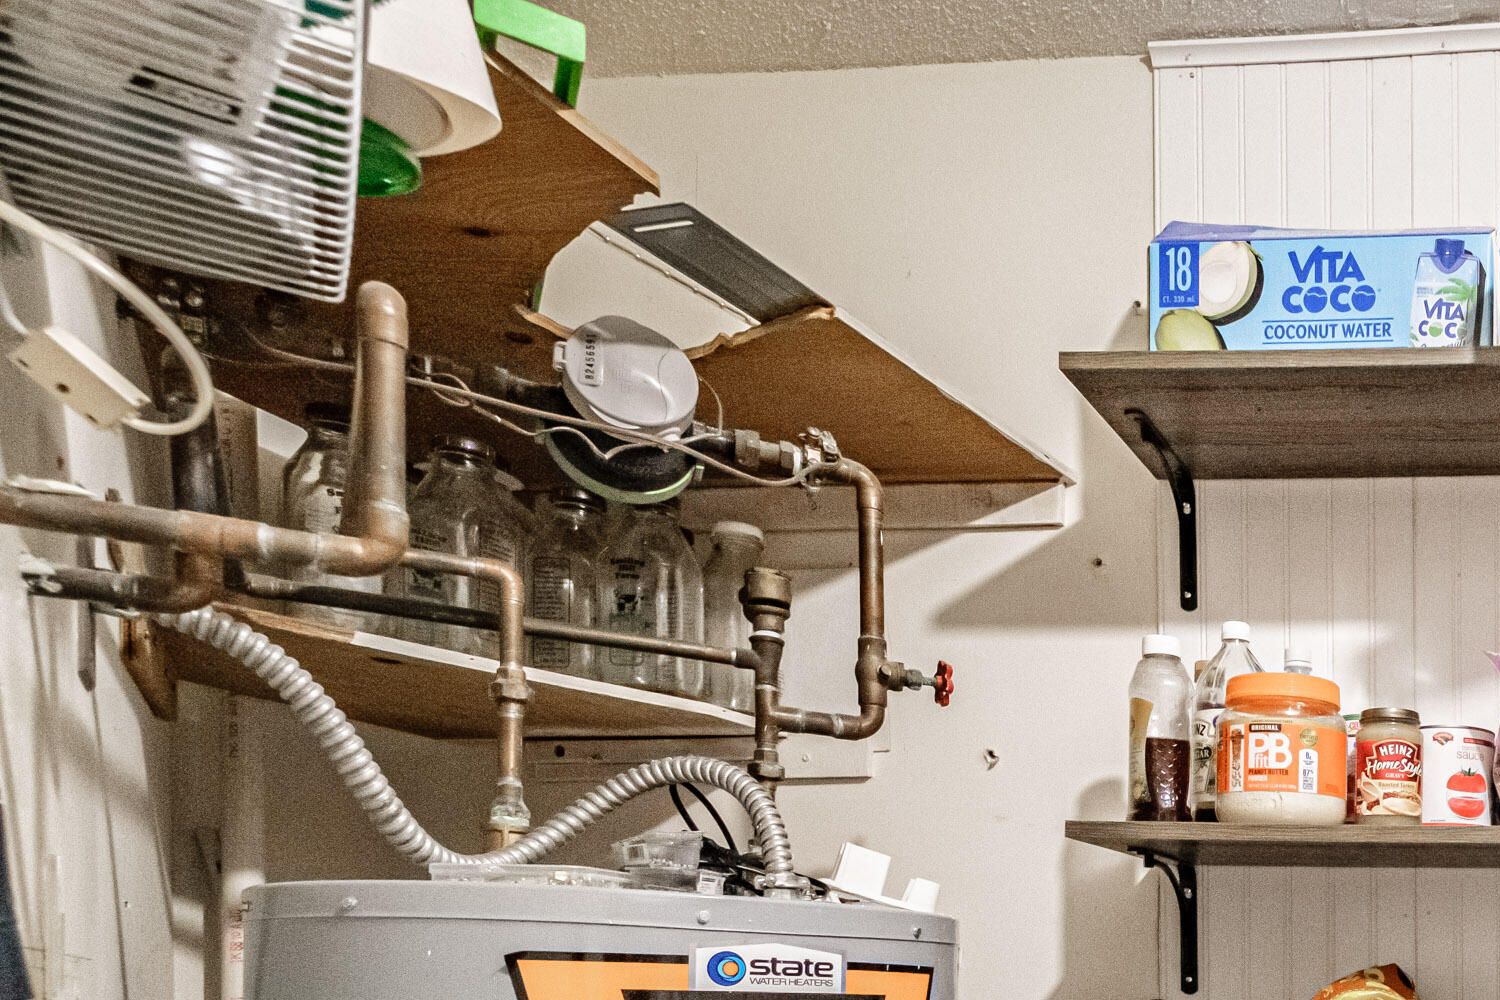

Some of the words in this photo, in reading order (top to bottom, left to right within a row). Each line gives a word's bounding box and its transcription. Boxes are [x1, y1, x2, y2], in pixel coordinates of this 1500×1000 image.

[1166, 247, 1192, 292] 18
[1288, 245, 1366, 284] VITA
[1281, 284, 1377, 314] COCO
[1424, 298, 1465, 321] VITA
[1264, 324, 1338, 340] COCONUT
[1341, 322, 1392, 338] WATER
[1379, 744, 1414, 758] HEINZ
[750, 957, 834, 978] state
[789, 978, 834, 987] HEATERS
